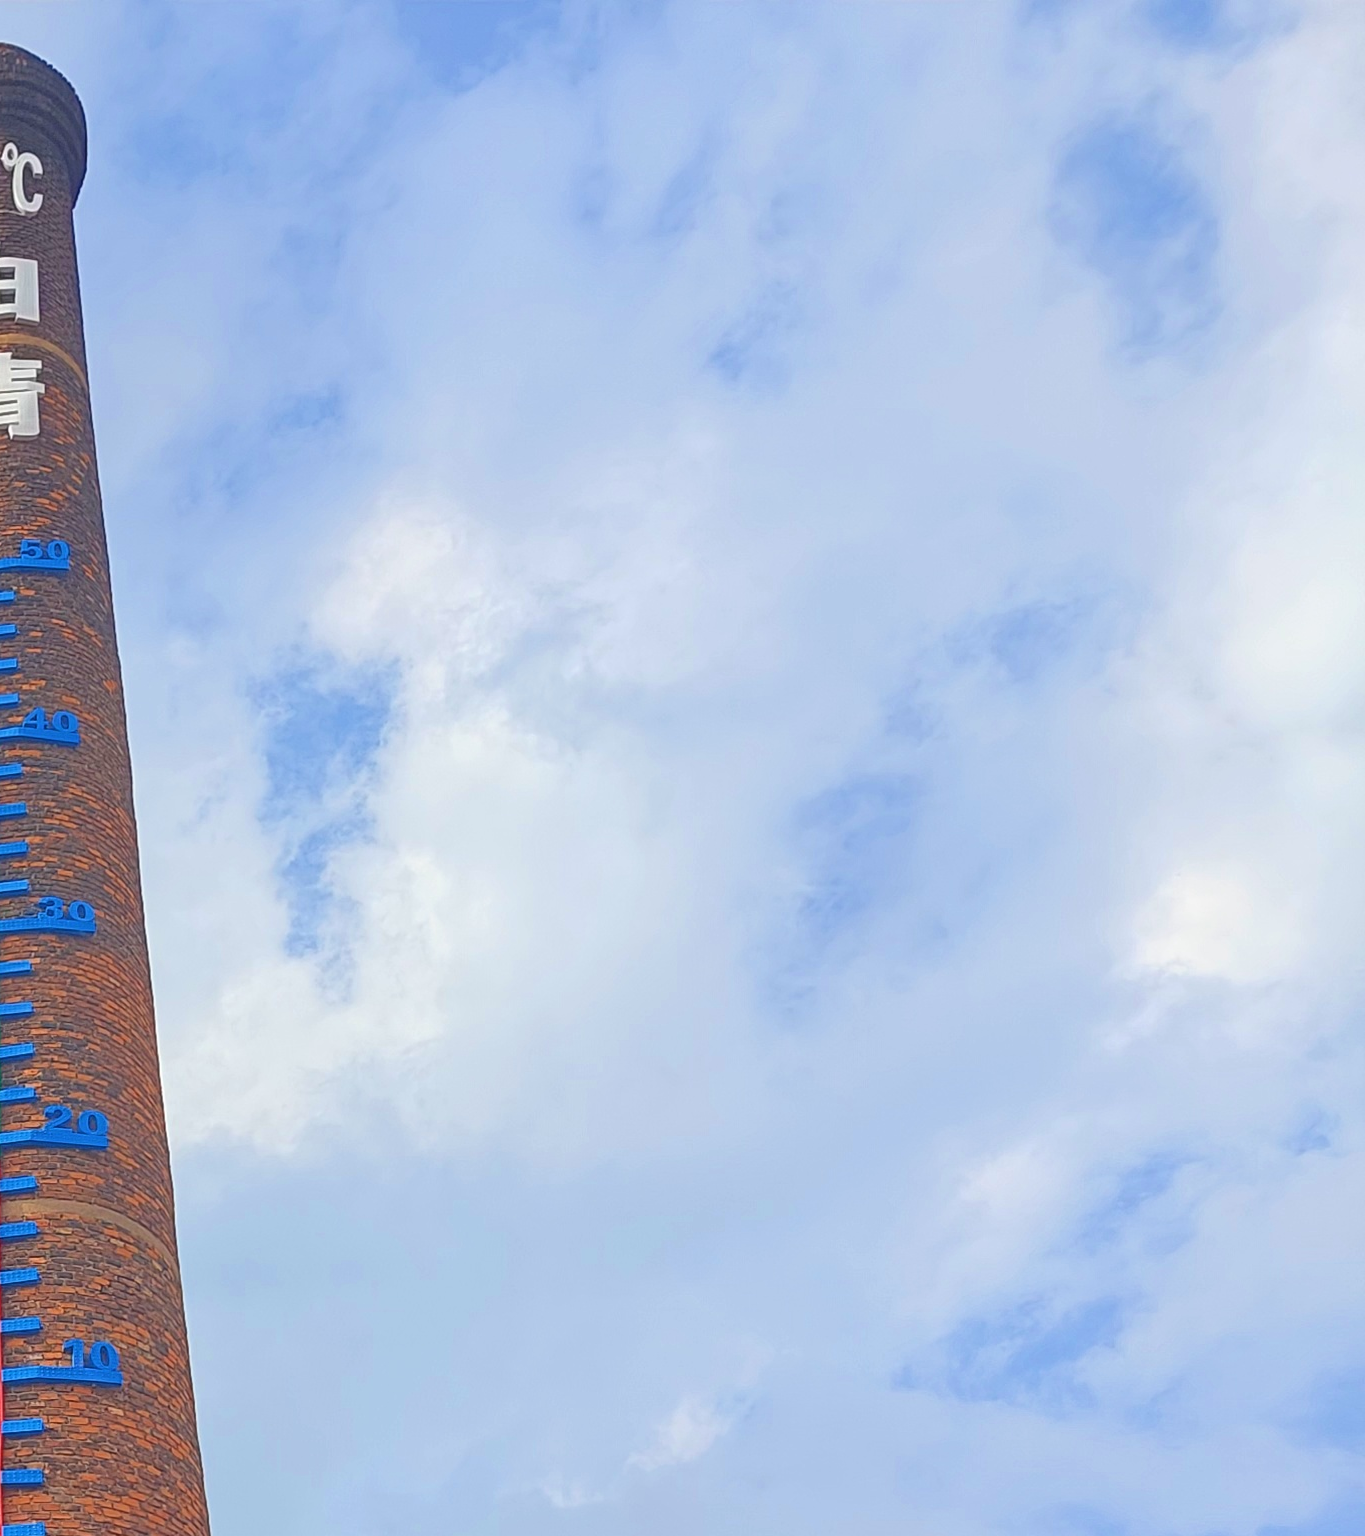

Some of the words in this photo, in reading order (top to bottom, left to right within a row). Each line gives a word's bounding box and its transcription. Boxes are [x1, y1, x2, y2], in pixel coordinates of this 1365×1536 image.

[20, 539, 70, 560] 50
[21, 707, 79, 733] 40
[37, 896, 96, 921] 30
[43, 1105, 108, 1136] 20
[63, 1338, 119, 1370] 10
